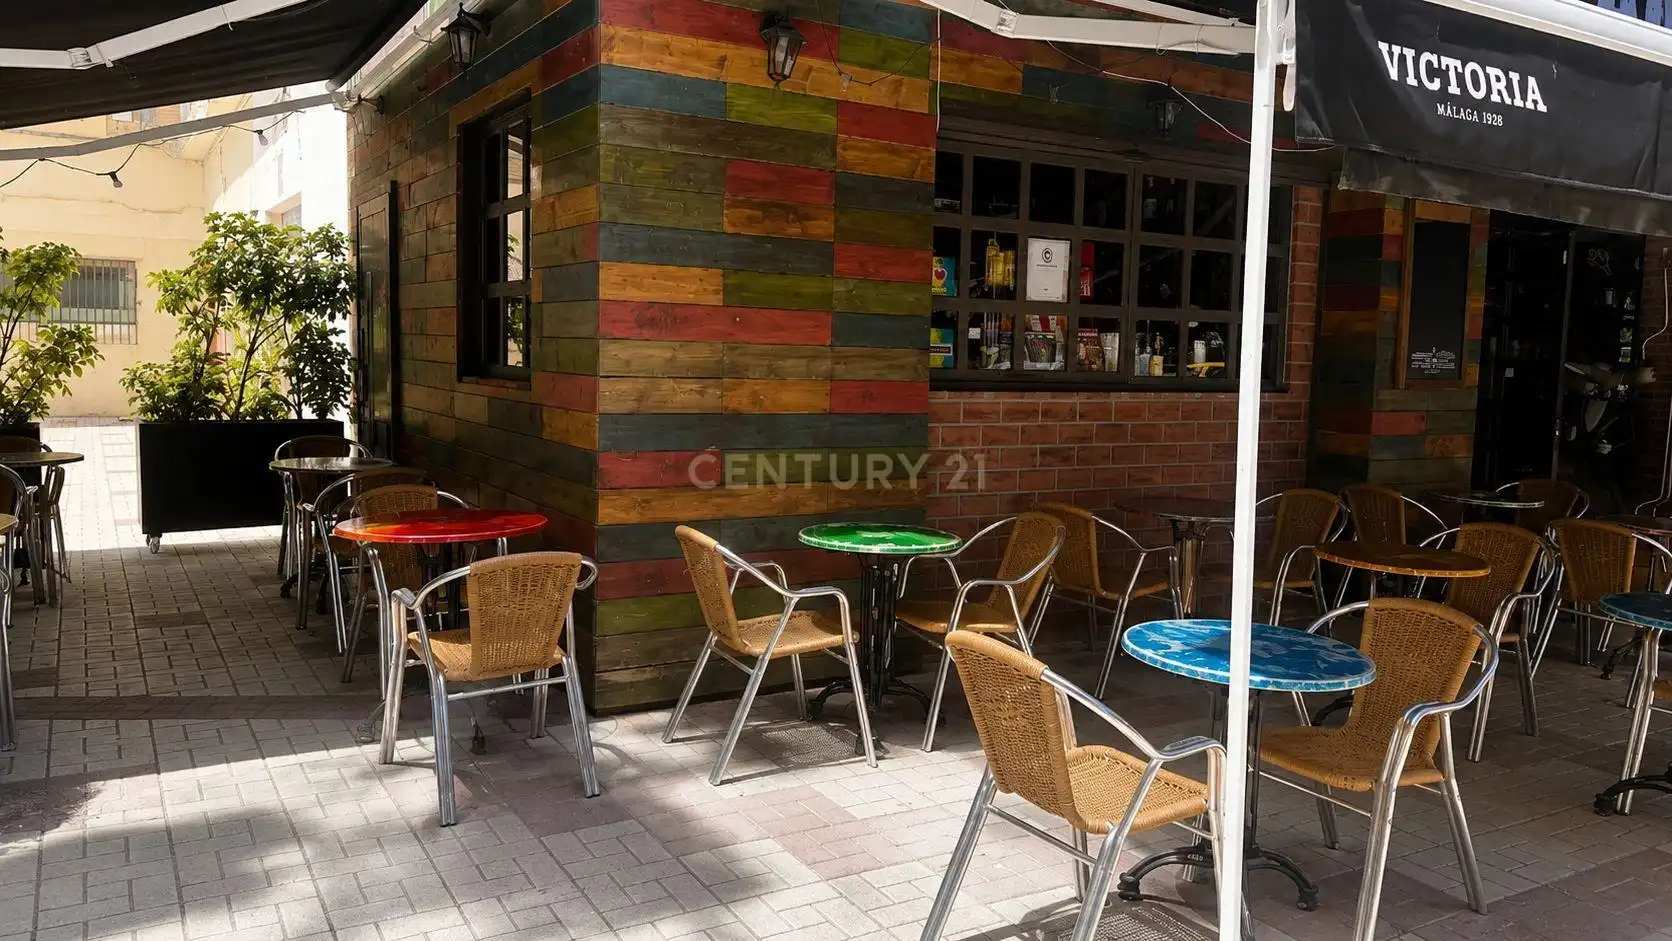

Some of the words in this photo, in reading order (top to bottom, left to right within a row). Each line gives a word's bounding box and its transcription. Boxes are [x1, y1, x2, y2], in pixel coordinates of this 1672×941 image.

[1378, 41, 1548, 112] VICTORIA
[1437, 101, 1479, 122] MÁLAGA
[1483, 112, 1503, 126] 1928
